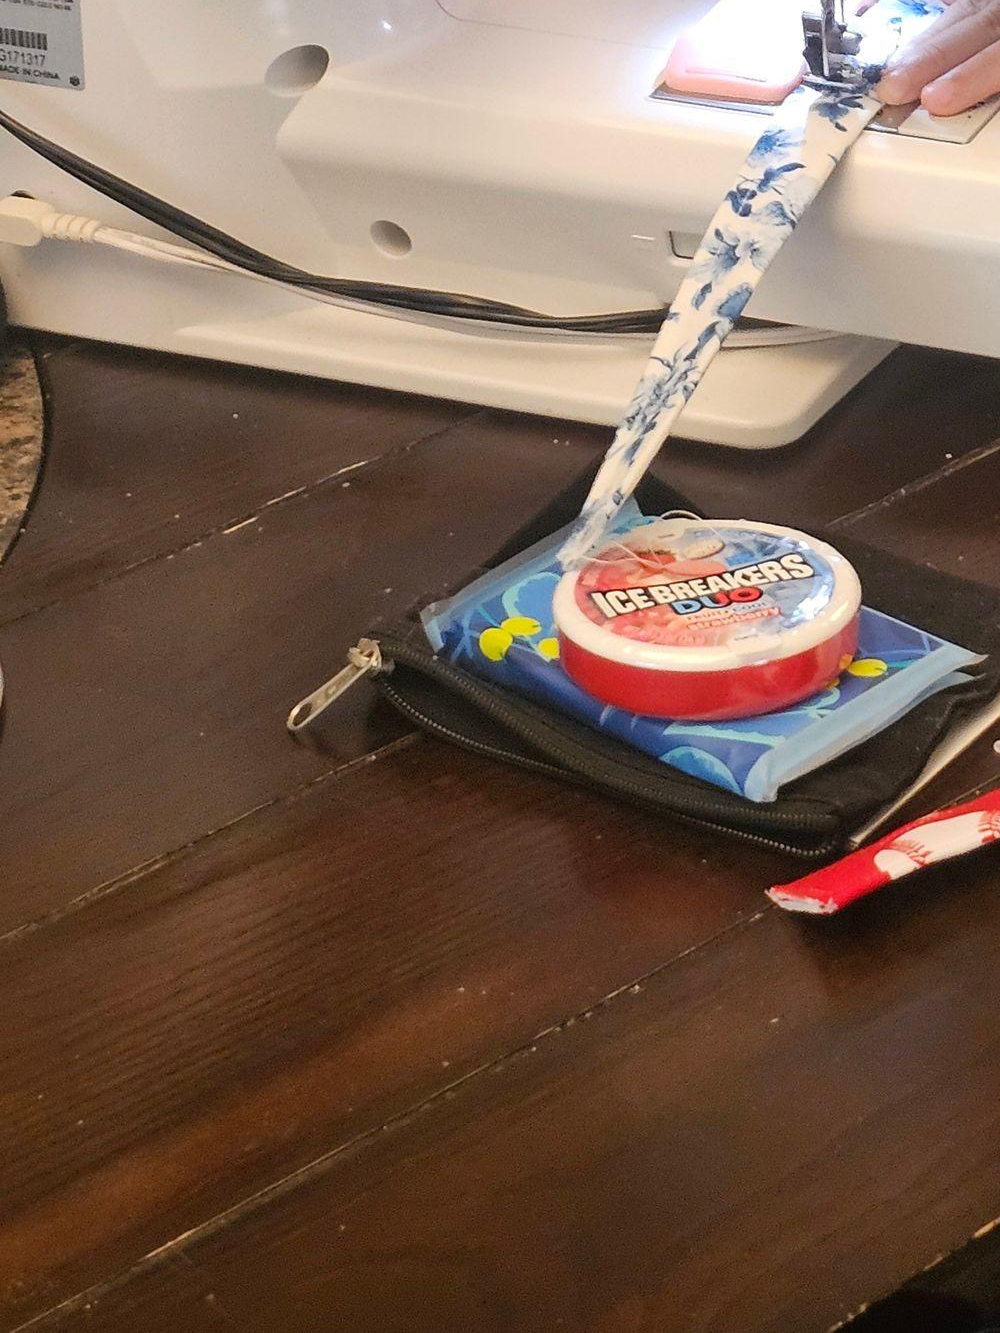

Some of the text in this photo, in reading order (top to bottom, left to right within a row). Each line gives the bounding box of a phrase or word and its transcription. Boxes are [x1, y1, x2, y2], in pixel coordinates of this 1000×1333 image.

[33, 69, 60, 79] CHINA
[591, 553, 815, 618] ICE BREAKERS
[672, 585, 764, 615] DUO
